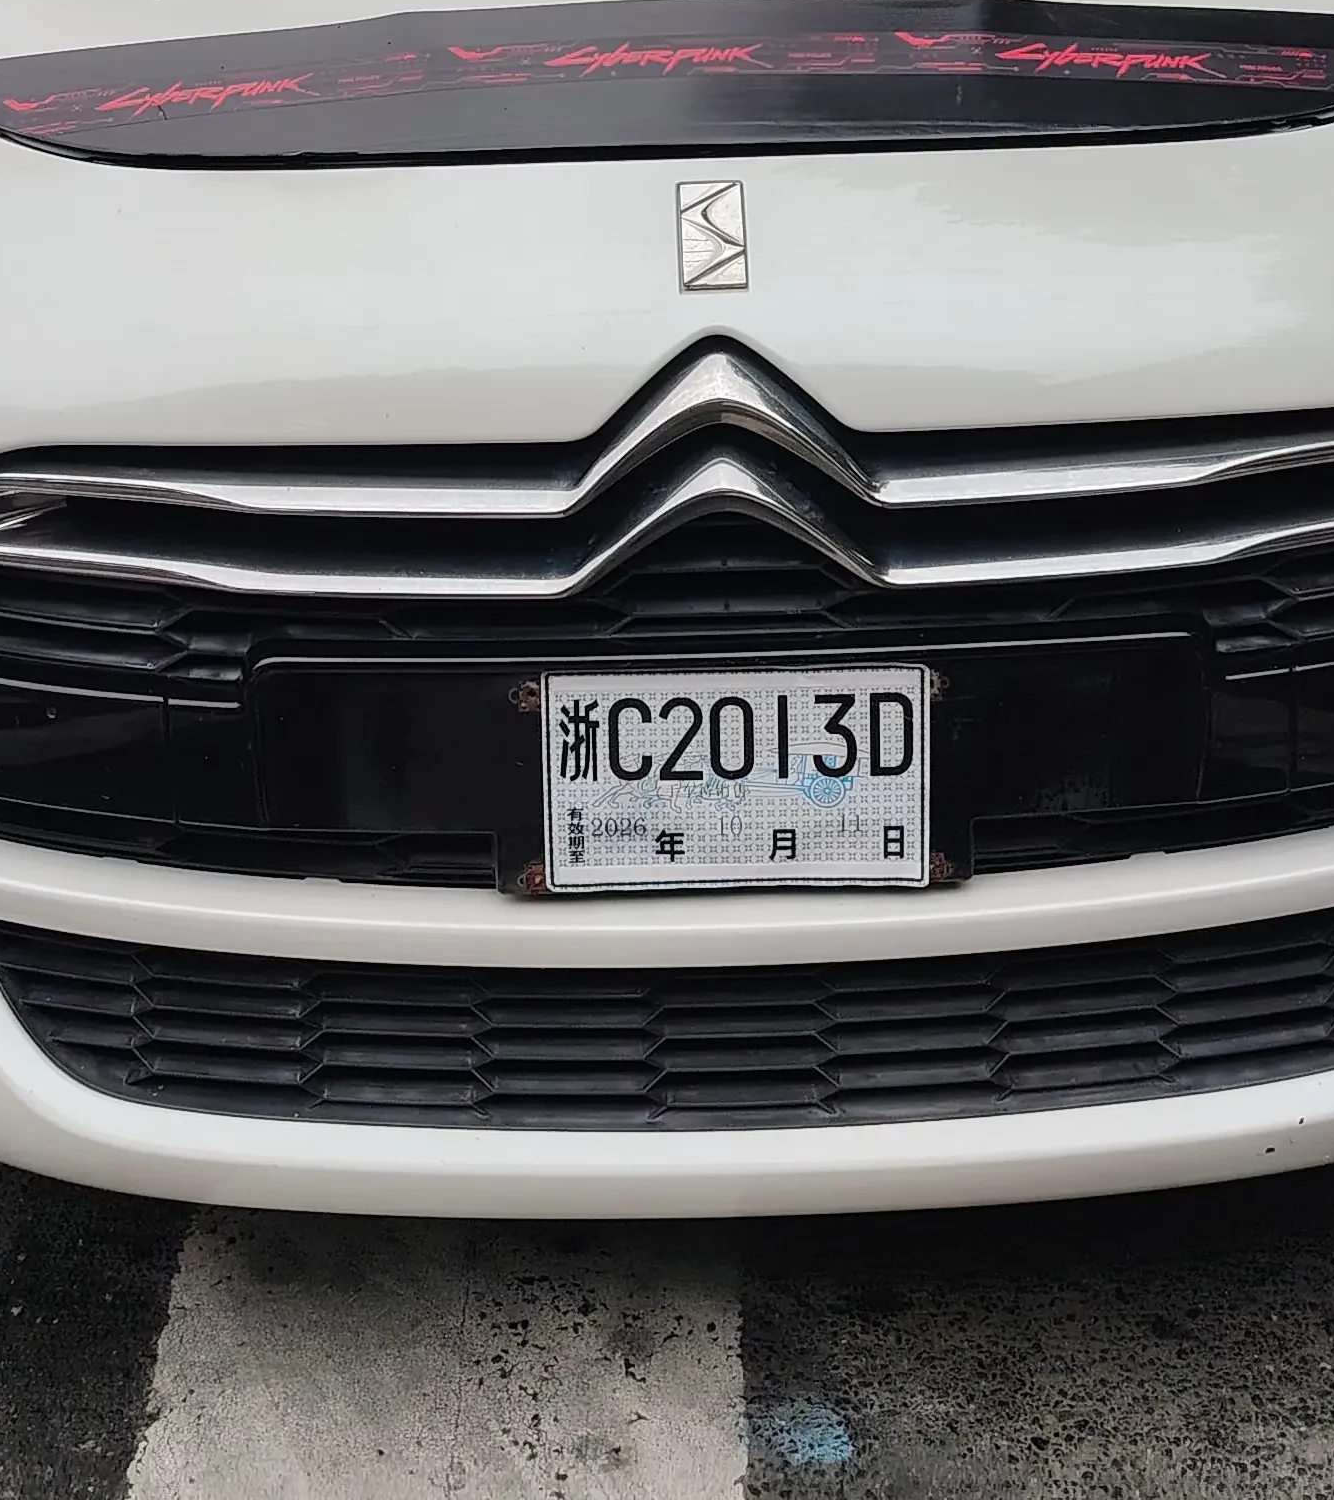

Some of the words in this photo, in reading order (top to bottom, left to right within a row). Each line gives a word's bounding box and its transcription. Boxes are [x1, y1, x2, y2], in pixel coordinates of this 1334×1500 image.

[559, 692, 914, 782] 浙C2013D
[567, 807, 585, 864] 有效期至
[591, 816, 647, 837] 2026
[655, 829, 685, 863] 年
[769, 828, 797, 861] 月
[883, 825, 905, 859] 日
